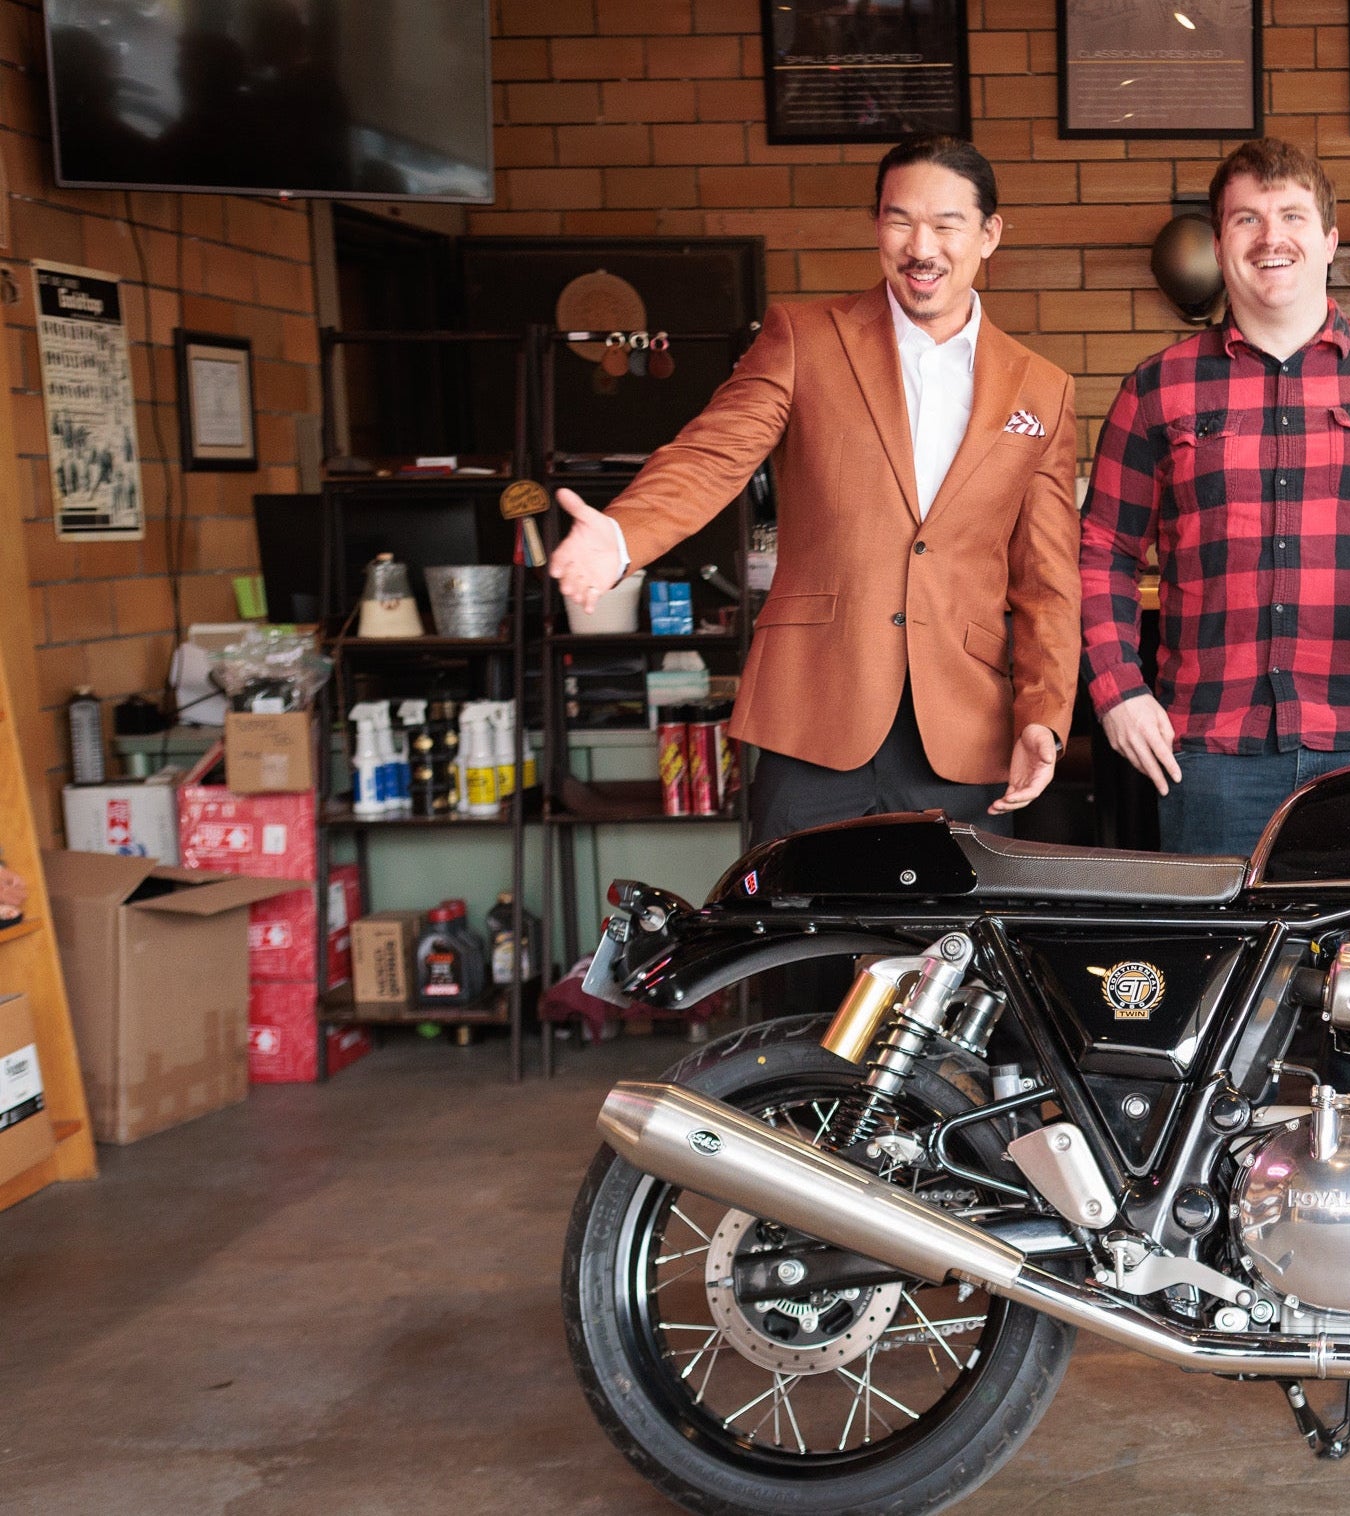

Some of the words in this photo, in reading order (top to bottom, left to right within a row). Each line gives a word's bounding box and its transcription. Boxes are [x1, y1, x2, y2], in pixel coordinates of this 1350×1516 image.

[1078, 49, 1157, 59] CLASSICALLY
[1159, 49, 1225, 59] DESIGNED
[1109, 964, 1158, 991] CONTINENTAL
[1117, 976, 1150, 1003] GT
[692, 1133, 722, 1151] S&S
[1288, 1188, 1350, 1208] ROYAL
